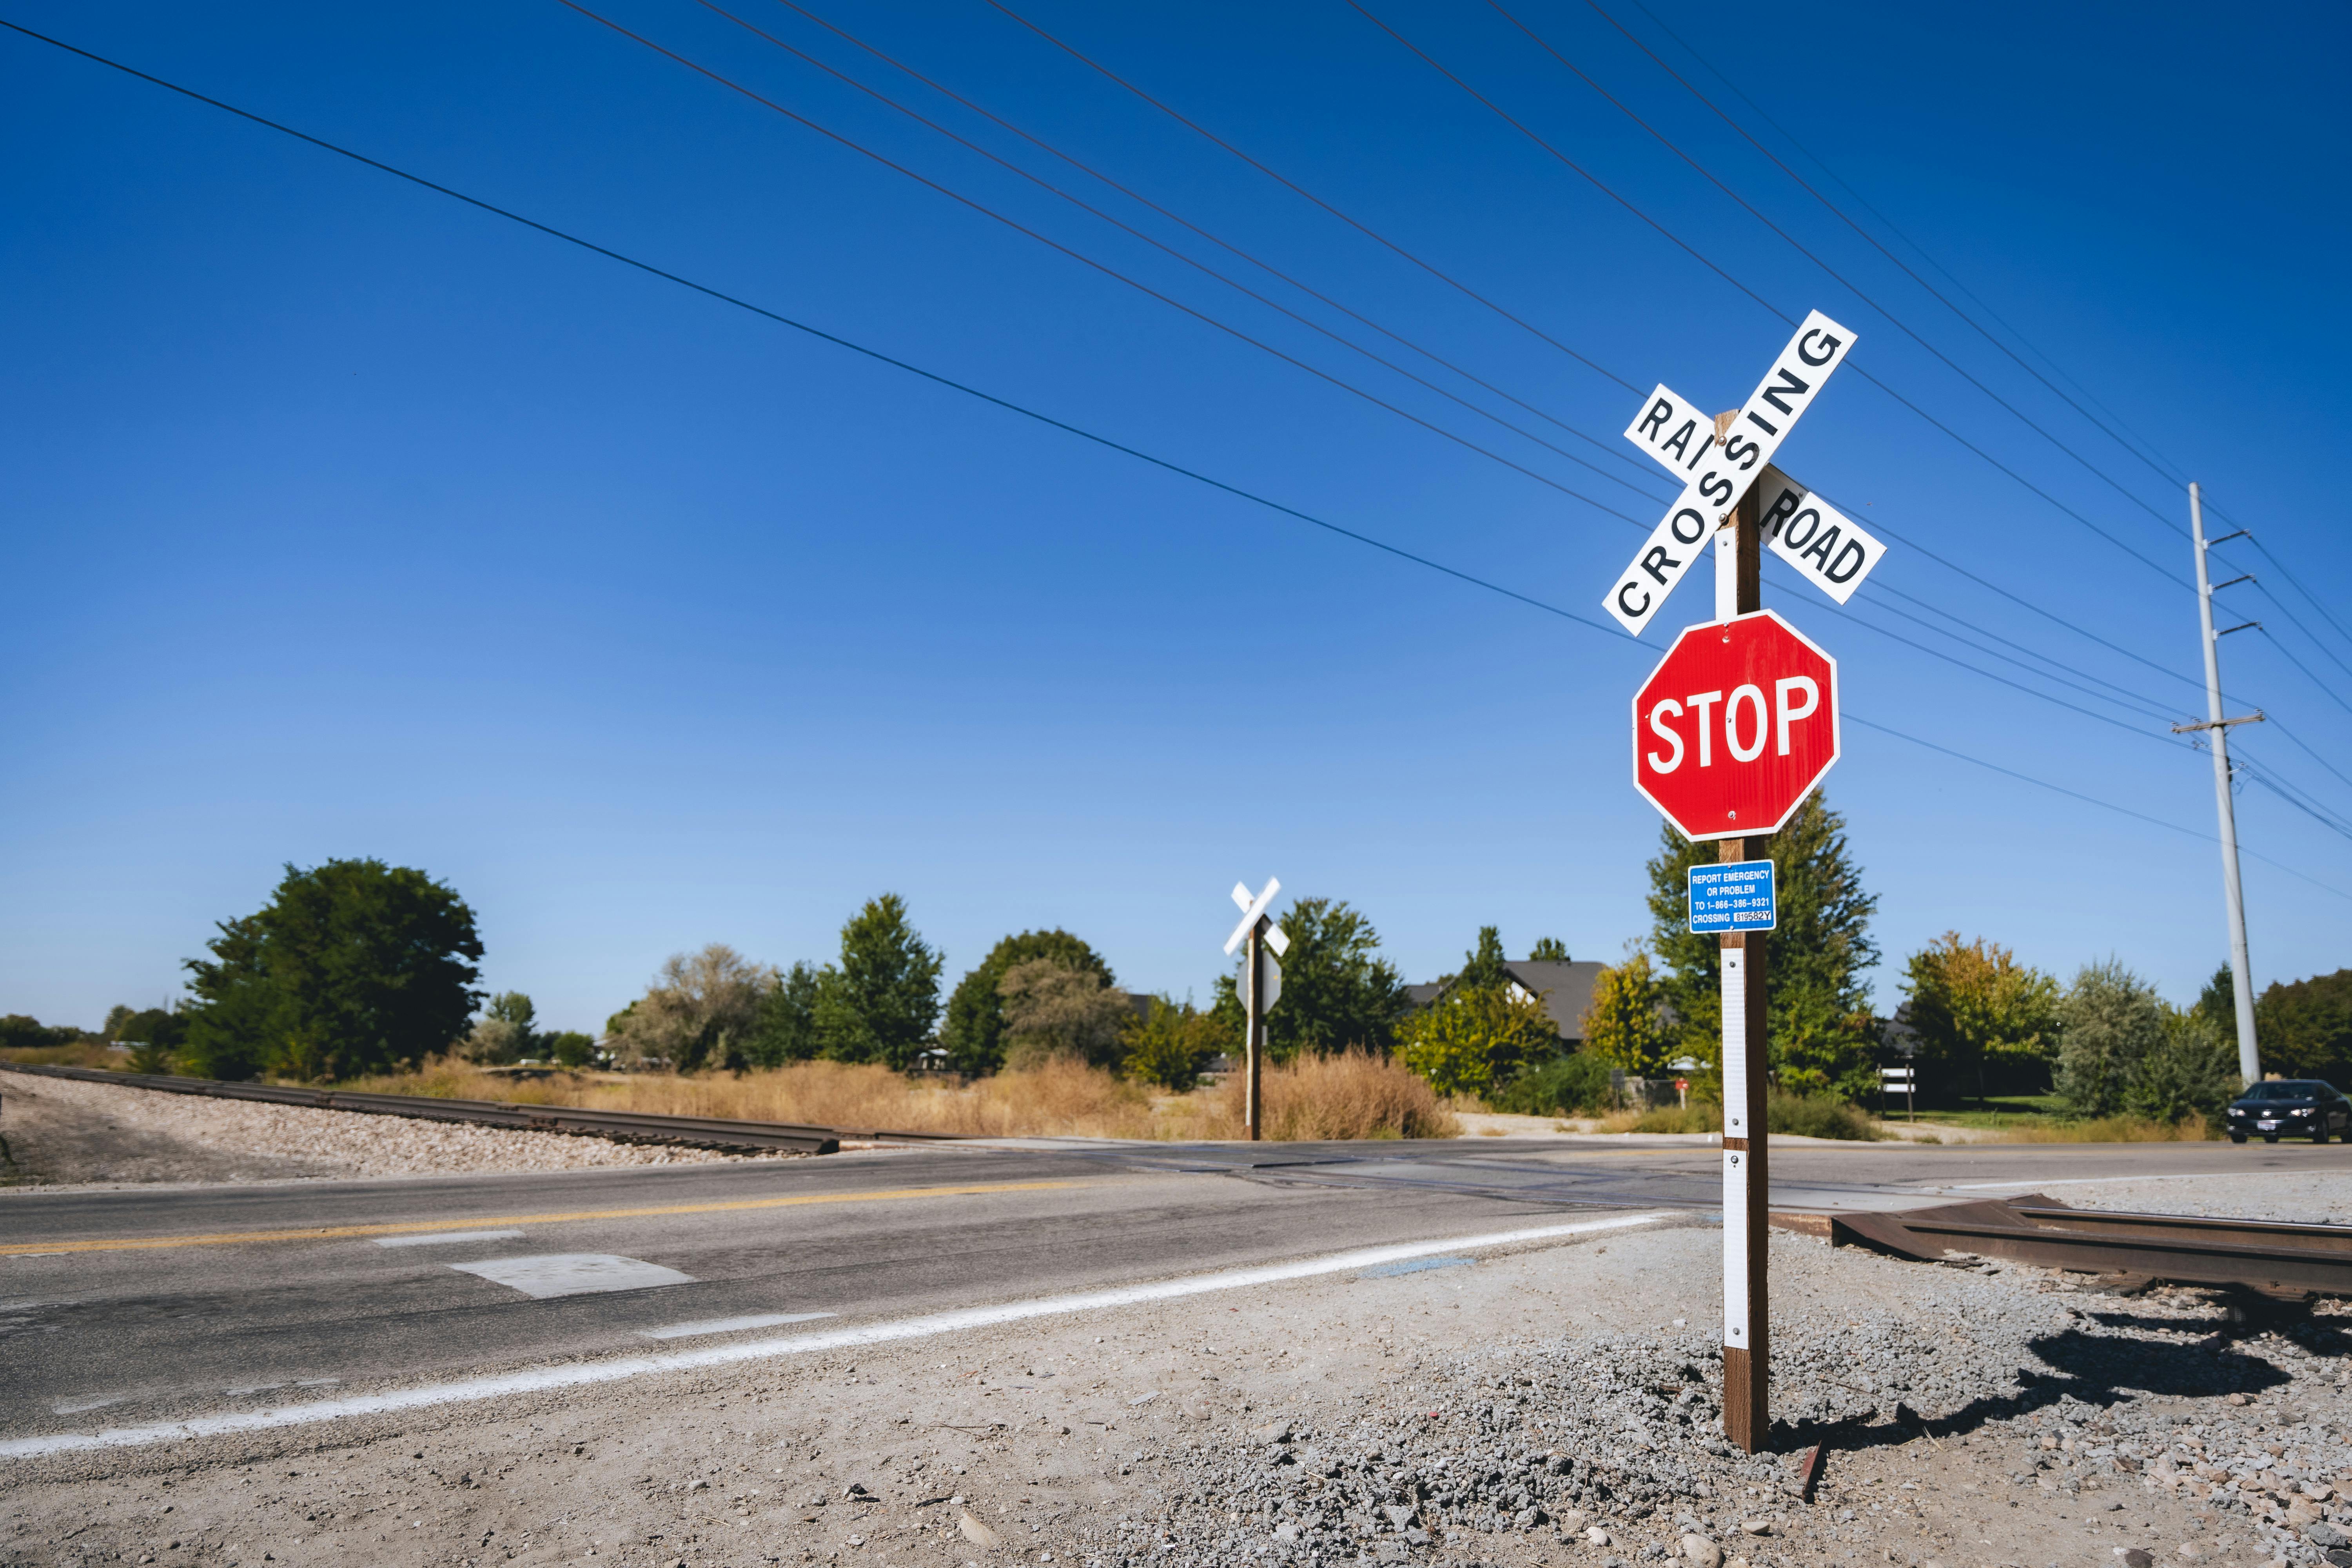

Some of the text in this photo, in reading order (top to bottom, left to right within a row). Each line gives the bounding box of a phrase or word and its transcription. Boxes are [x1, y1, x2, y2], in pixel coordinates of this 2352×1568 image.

[1618, 328, 1842, 617] CROSSING
[1638, 397, 1865, 584] RAI ROAD
[1648, 676, 1819, 774] STOP
[1692, 870, 1769, 884] REPORT EMERGENCY
[1707, 884, 1755, 897] OR PROBLEM
[1695, 897, 1769, 910] TO 1-866-386-9321
[1693, 911, 1771, 924] CROSSING 819582Y
